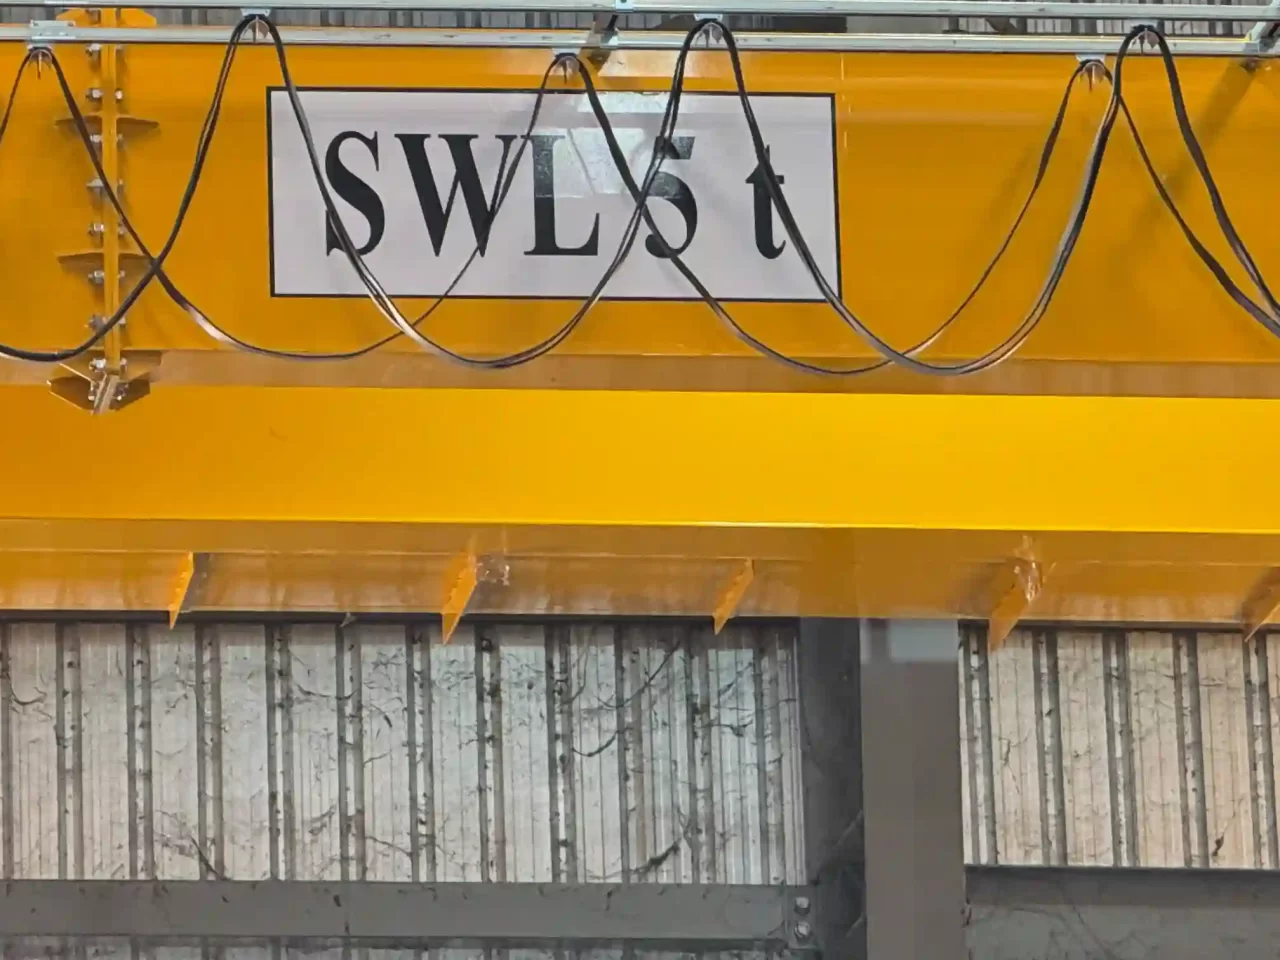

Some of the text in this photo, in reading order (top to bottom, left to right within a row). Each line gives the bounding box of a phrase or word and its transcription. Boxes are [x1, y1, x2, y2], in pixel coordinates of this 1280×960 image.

[325, 130, 786, 259] SWL 5 t
